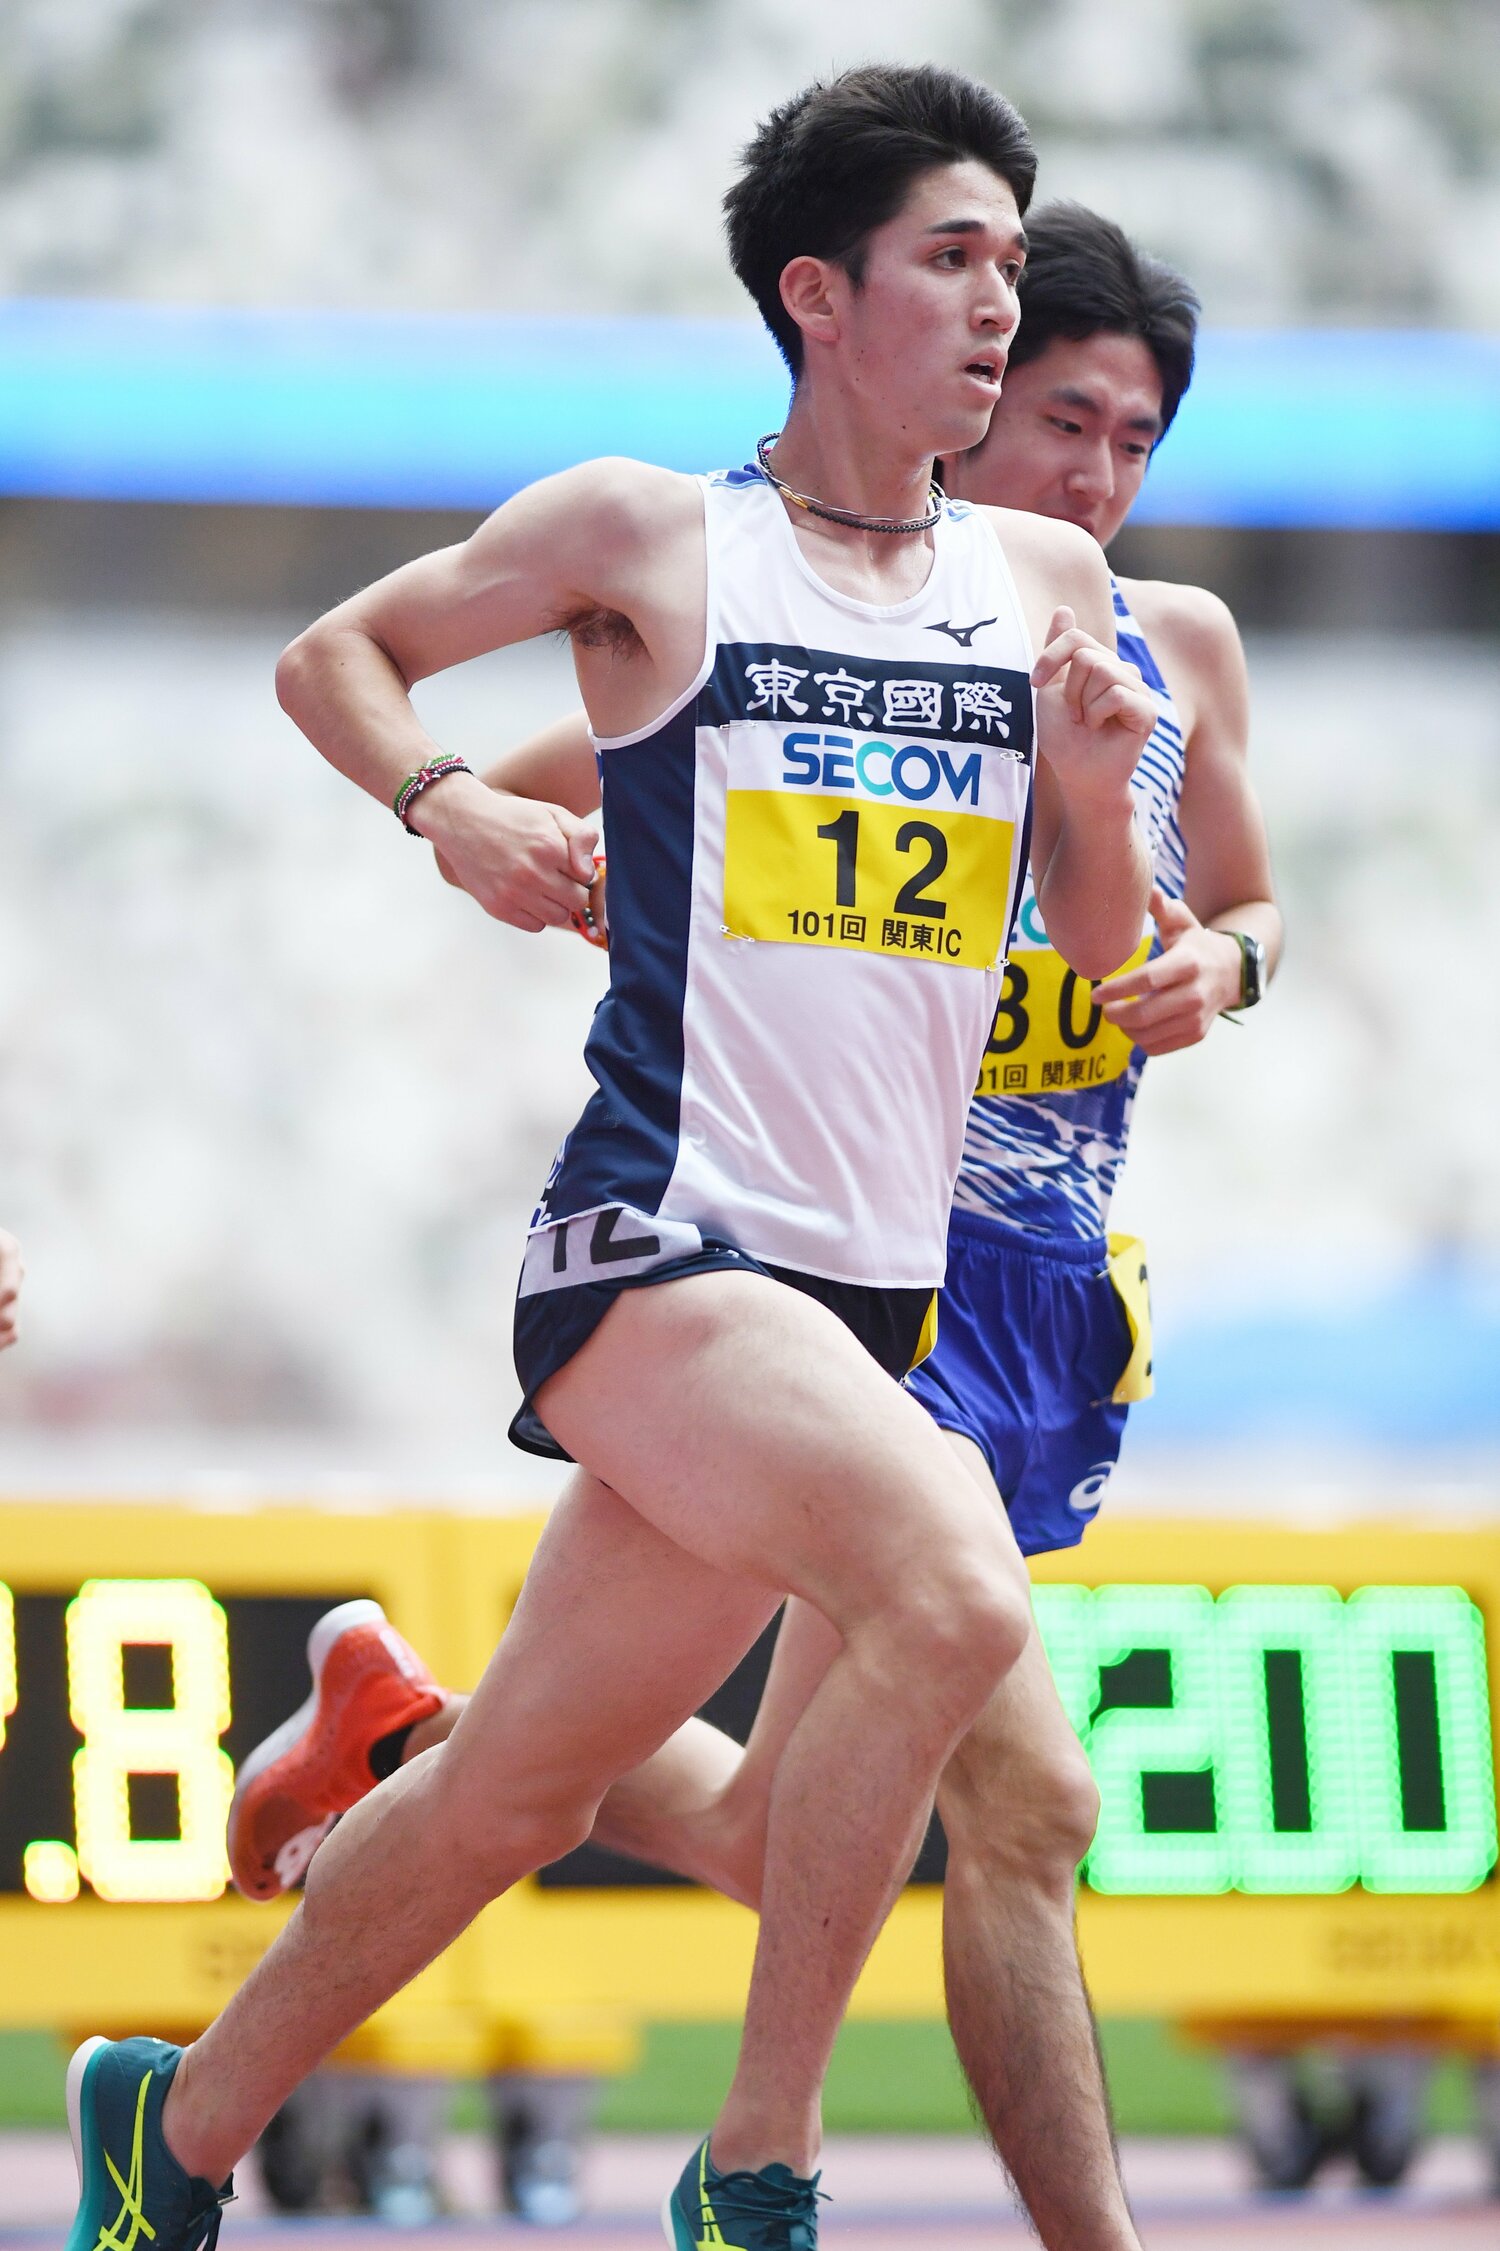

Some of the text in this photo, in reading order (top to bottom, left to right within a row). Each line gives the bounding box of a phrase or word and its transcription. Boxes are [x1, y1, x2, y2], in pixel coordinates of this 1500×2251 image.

[744, 657, 1012, 739] 東京國際
[782, 732, 982, 807] SECOM
[816, 809, 949, 920] 12
[787, 909, 962, 957] 101回 関東IC
[1041, 1053, 1107, 1087] 関東IC
